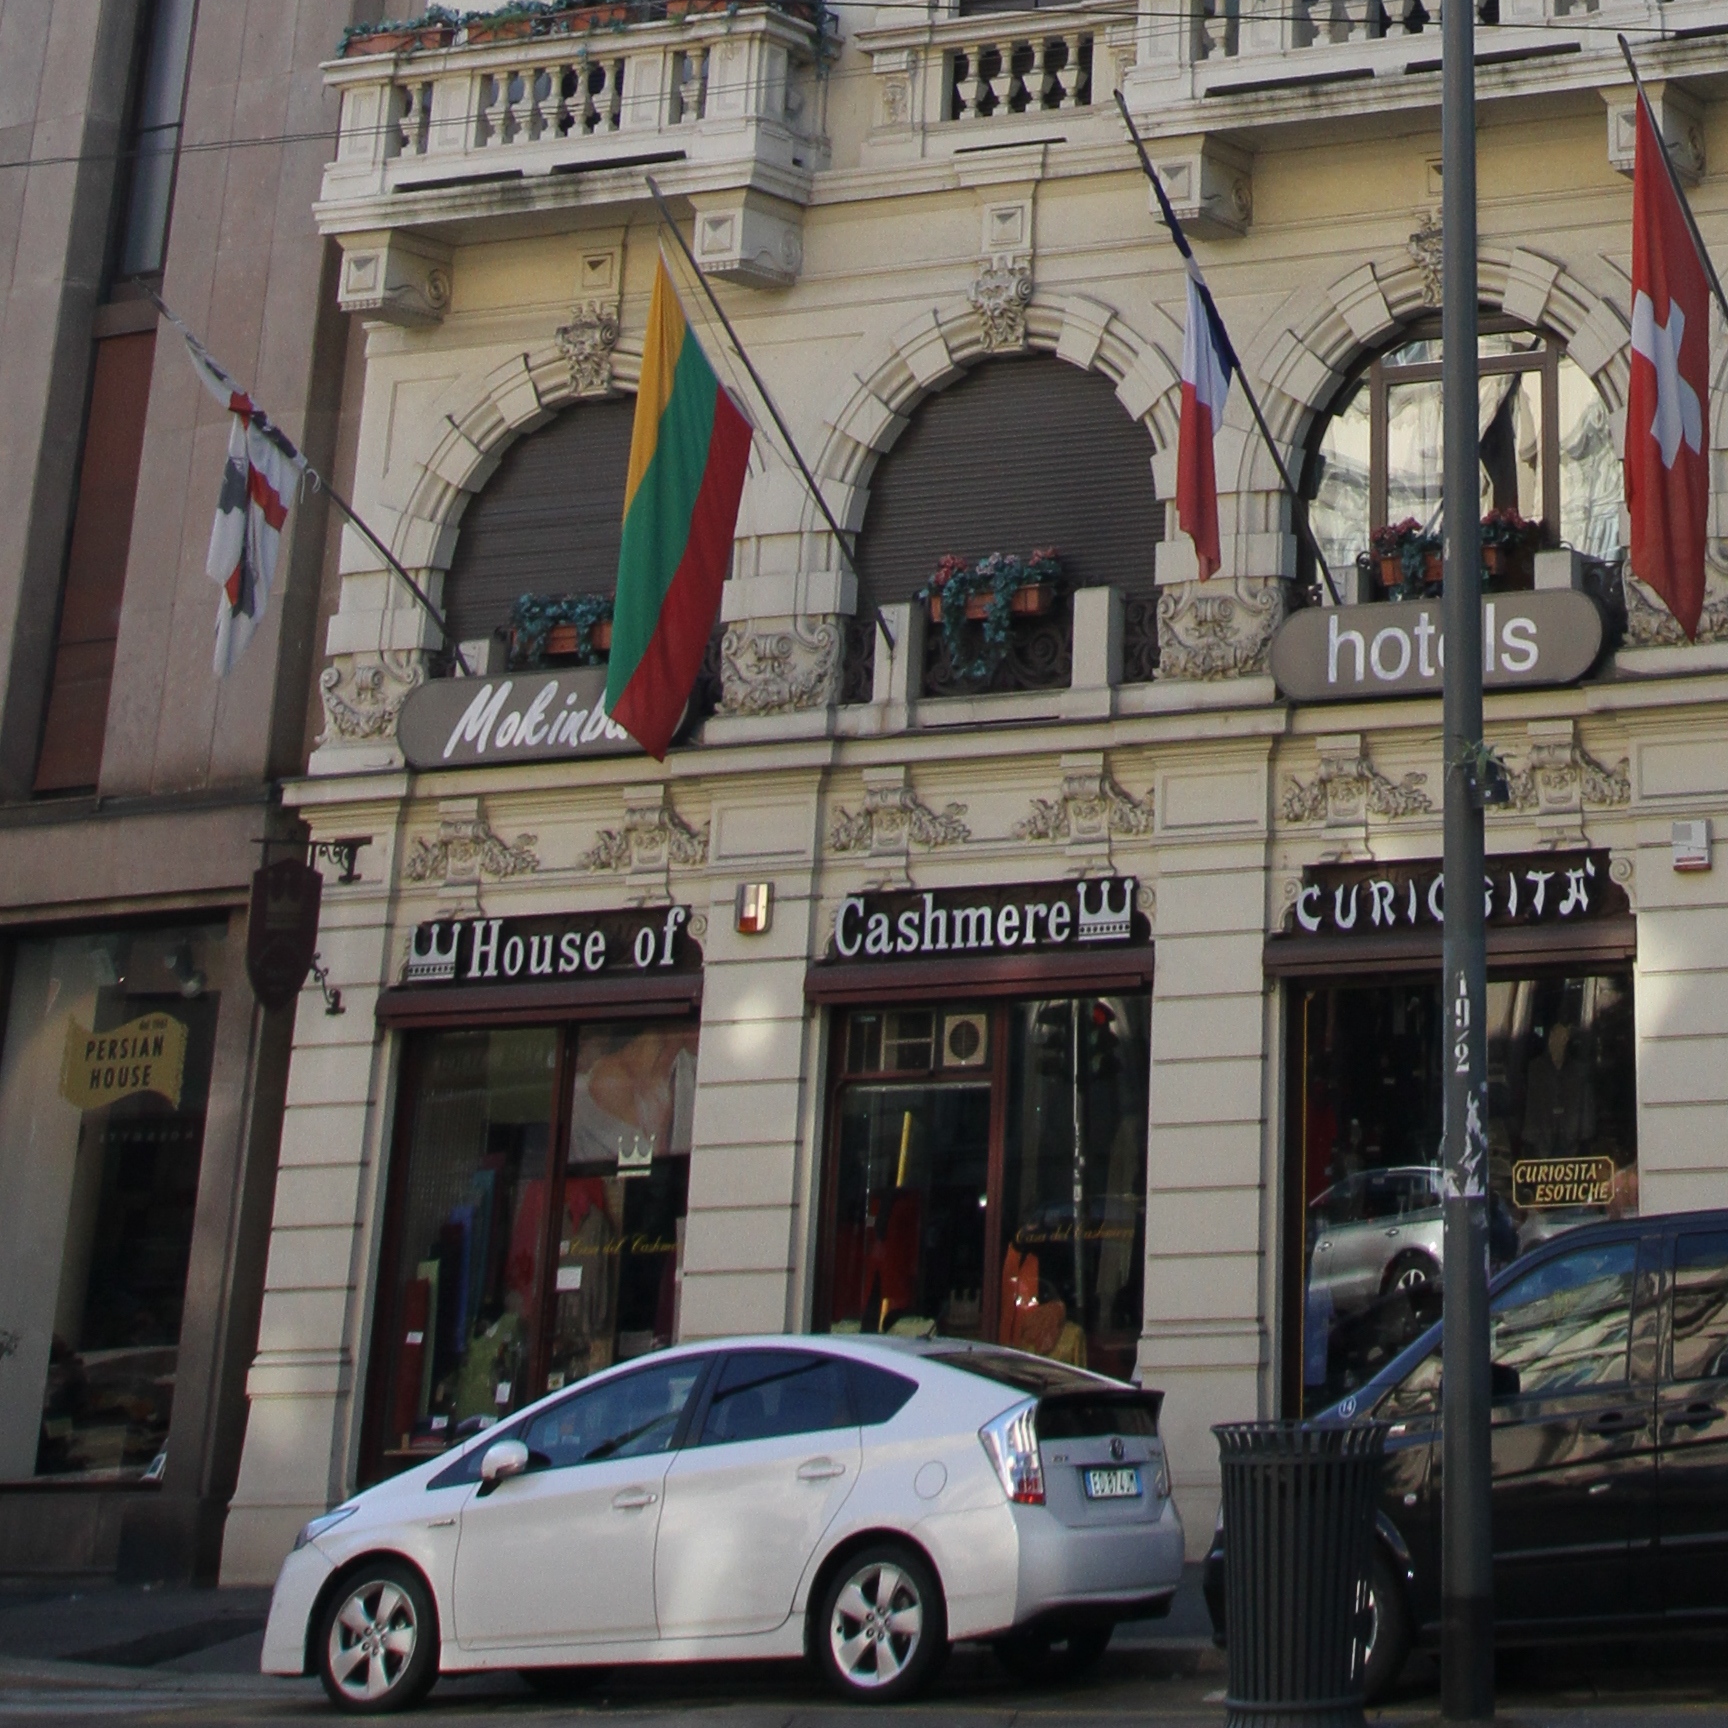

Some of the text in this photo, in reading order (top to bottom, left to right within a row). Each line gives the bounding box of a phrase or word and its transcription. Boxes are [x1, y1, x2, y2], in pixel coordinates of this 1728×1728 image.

[1327, 602, 1539, 684] hotls
[466, 906, 685, 978] House of
[834, 892, 1071, 956] Cashmere
[85, 1035, 164, 1062] PERSIAN
[89, 1064, 153, 1090] HOUSE
[1535, 1182, 1608, 1202] ESOTICHE
